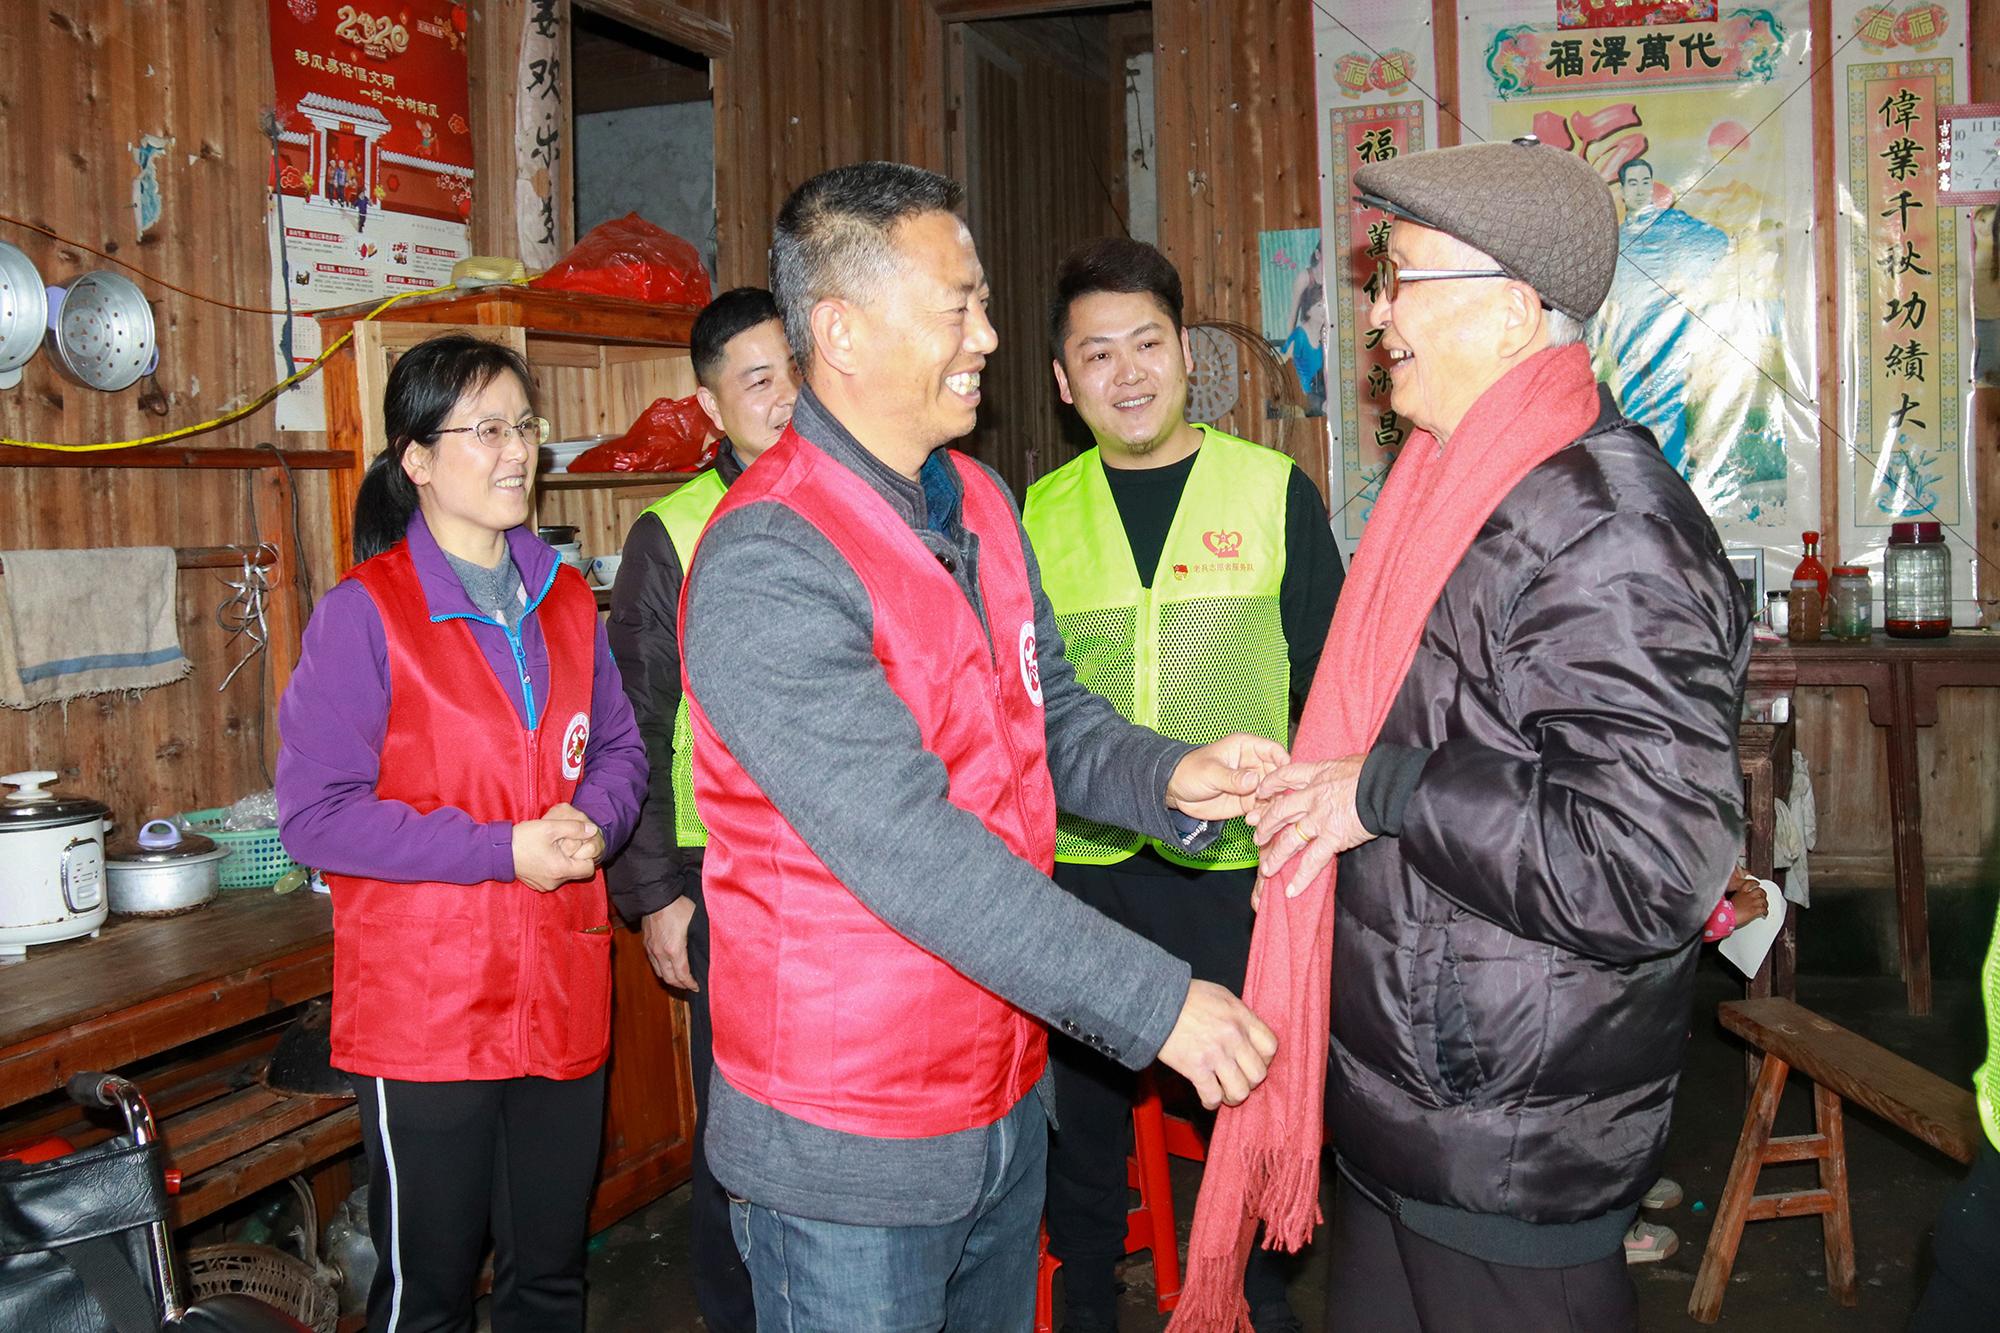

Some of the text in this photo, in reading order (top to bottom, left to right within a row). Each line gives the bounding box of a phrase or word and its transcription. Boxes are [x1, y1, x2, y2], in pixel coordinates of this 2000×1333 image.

[335, 5, 410, 53] 2020
[1863, 9, 1936, 41] 福 福
[294, 48, 396, 90] 移风易俗倡文明
[1546, 32, 1722, 78] 福澤萬代
[1344, 59, 1370, 87] 福
[1954, 129, 1966, 141] 10
[1972, 121, 1983, 132] 11
[1937, 119, 1952, 192] 吉祥如意
[1955, 151, 1965, 161] 9
[1972, 178, 1982, 189] 7
[1877, 89, 1932, 430] 偉業千秋功績大
